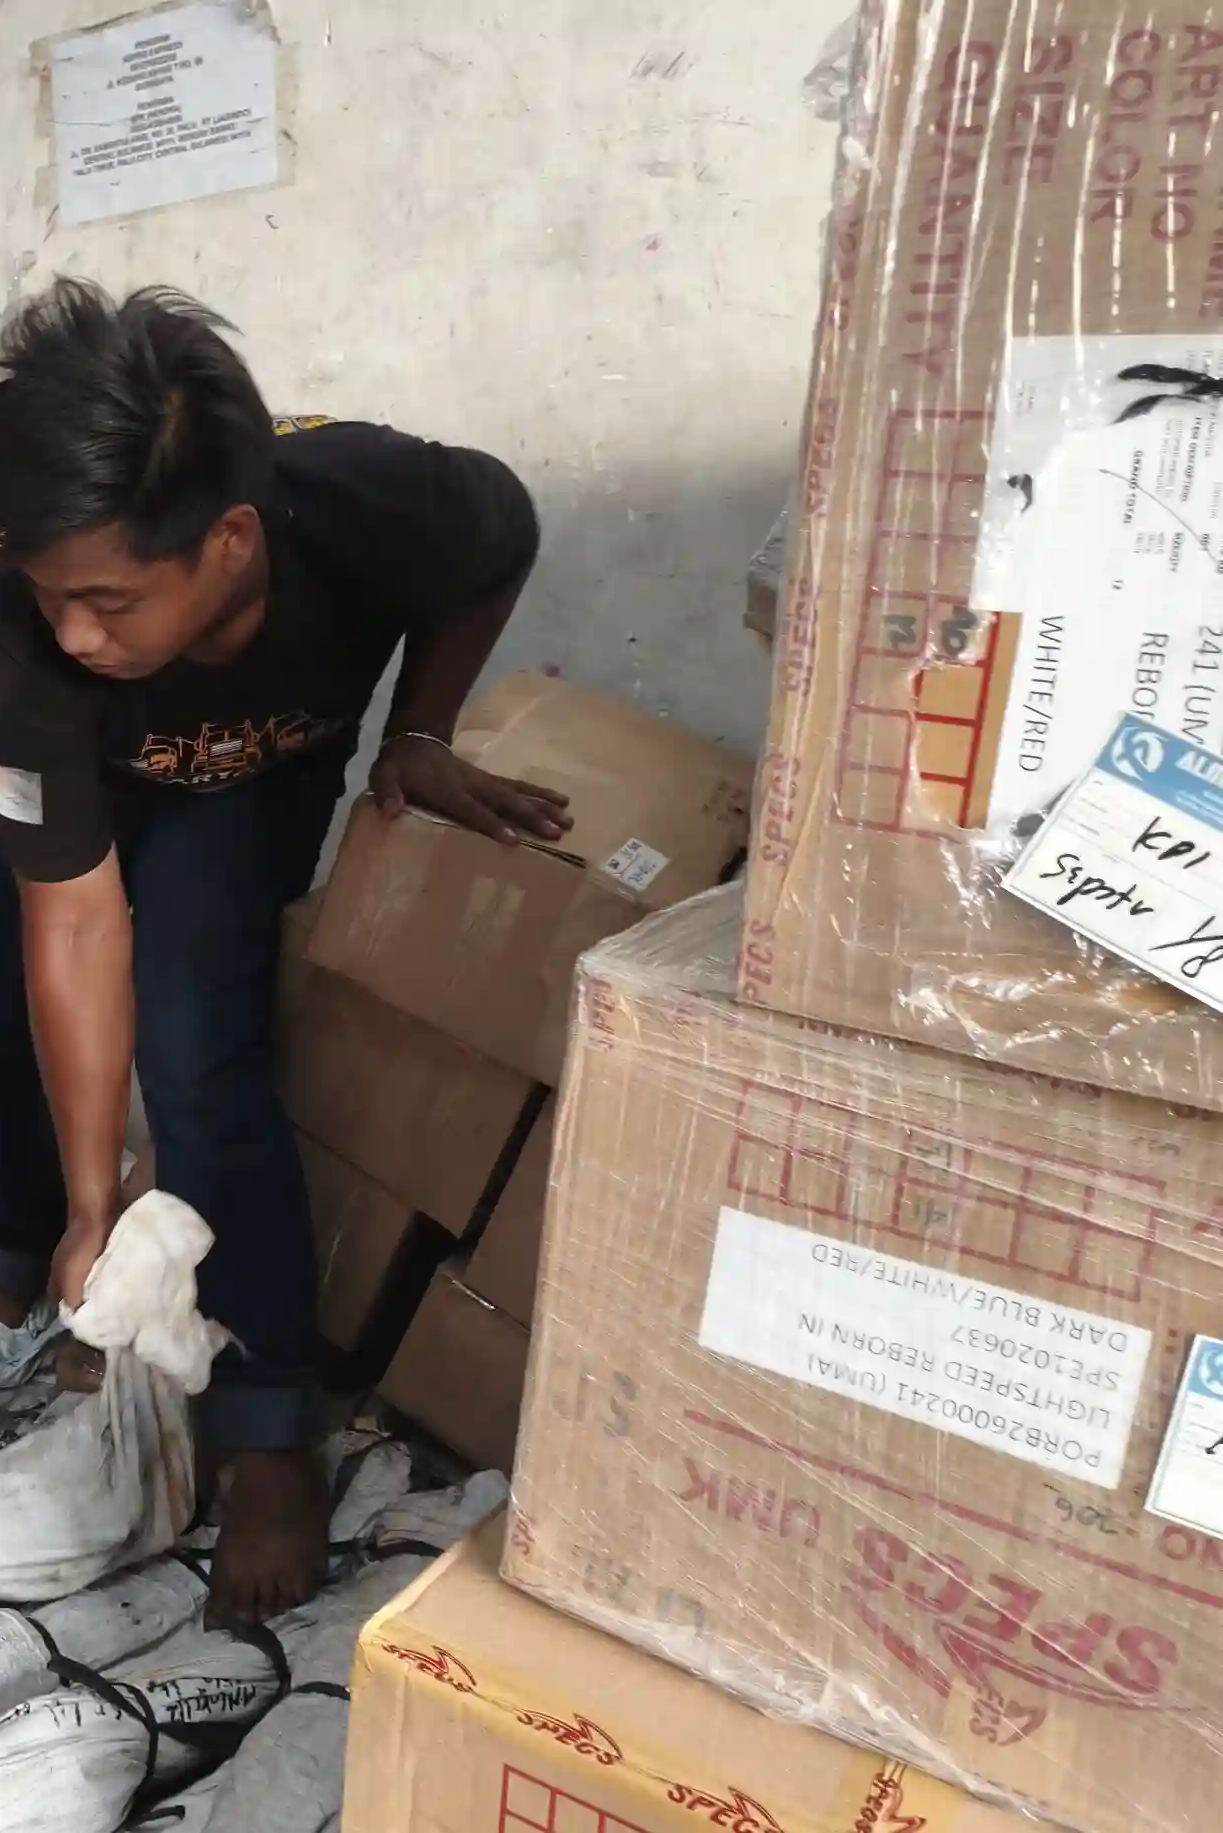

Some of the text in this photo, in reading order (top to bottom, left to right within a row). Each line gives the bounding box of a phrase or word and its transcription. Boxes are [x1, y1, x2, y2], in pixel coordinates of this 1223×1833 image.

[1001, 35, 1074, 186] SIZE
[1089, 29, 1161, 223] COLOR
[1168, 25, 1223, 128] ART
[901, 40, 995, 373] QUANTITY
[1150, 164, 1203, 243] NO
[1017, 615, 1065, 773] WHITE/RED
[743, 917, 777, 1001] PECS
[810, 1243, 1128, 1353] DARK BLUE/WHITE/RED
[797, 1311, 1112, 1431] LIGHTSPEED REBORN IN
[950, 1324, 1122, 1391] SPE1020637
[895, 1381, 1103, 1468] PORB26000241
[846, 1526, 1179, 1697] SPECS
[666, 1782, 763, 1833] SPEC
